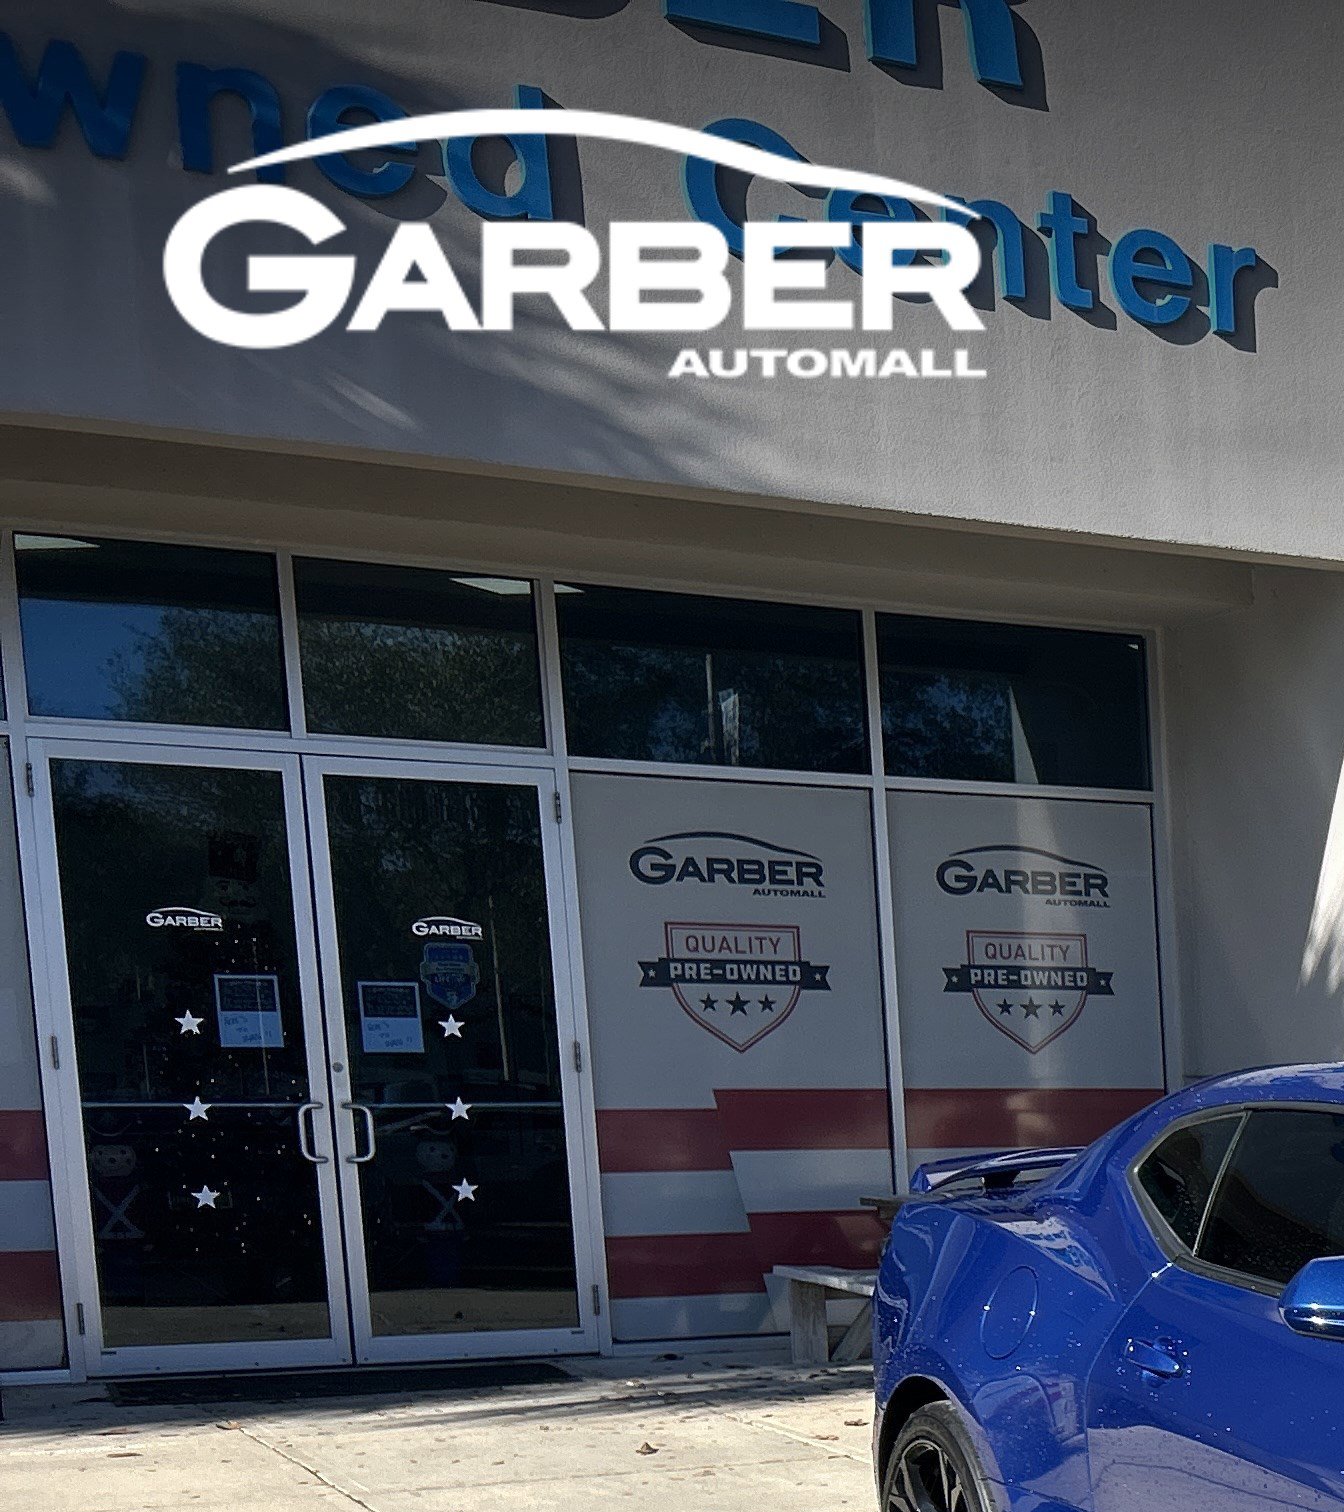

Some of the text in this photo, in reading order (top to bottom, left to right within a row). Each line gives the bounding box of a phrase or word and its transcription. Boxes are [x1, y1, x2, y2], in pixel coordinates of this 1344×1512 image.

[629, 846, 825, 889] GARBER
[936, 858, 1109, 899] GARBER
[751, 886, 827, 899] AUTOMALL
[1044, 897, 1111, 909] AUTOMALL
[146, 912, 223, 928] GARBER
[412, 921, 483, 937] GARBER
[684, 934, 781, 956] QUALITY
[983, 941, 1069, 963] QUALITY
[668, 961, 802, 984] PRE-OWNED
[969, 967, 1089, 988] PRE-OWNED
